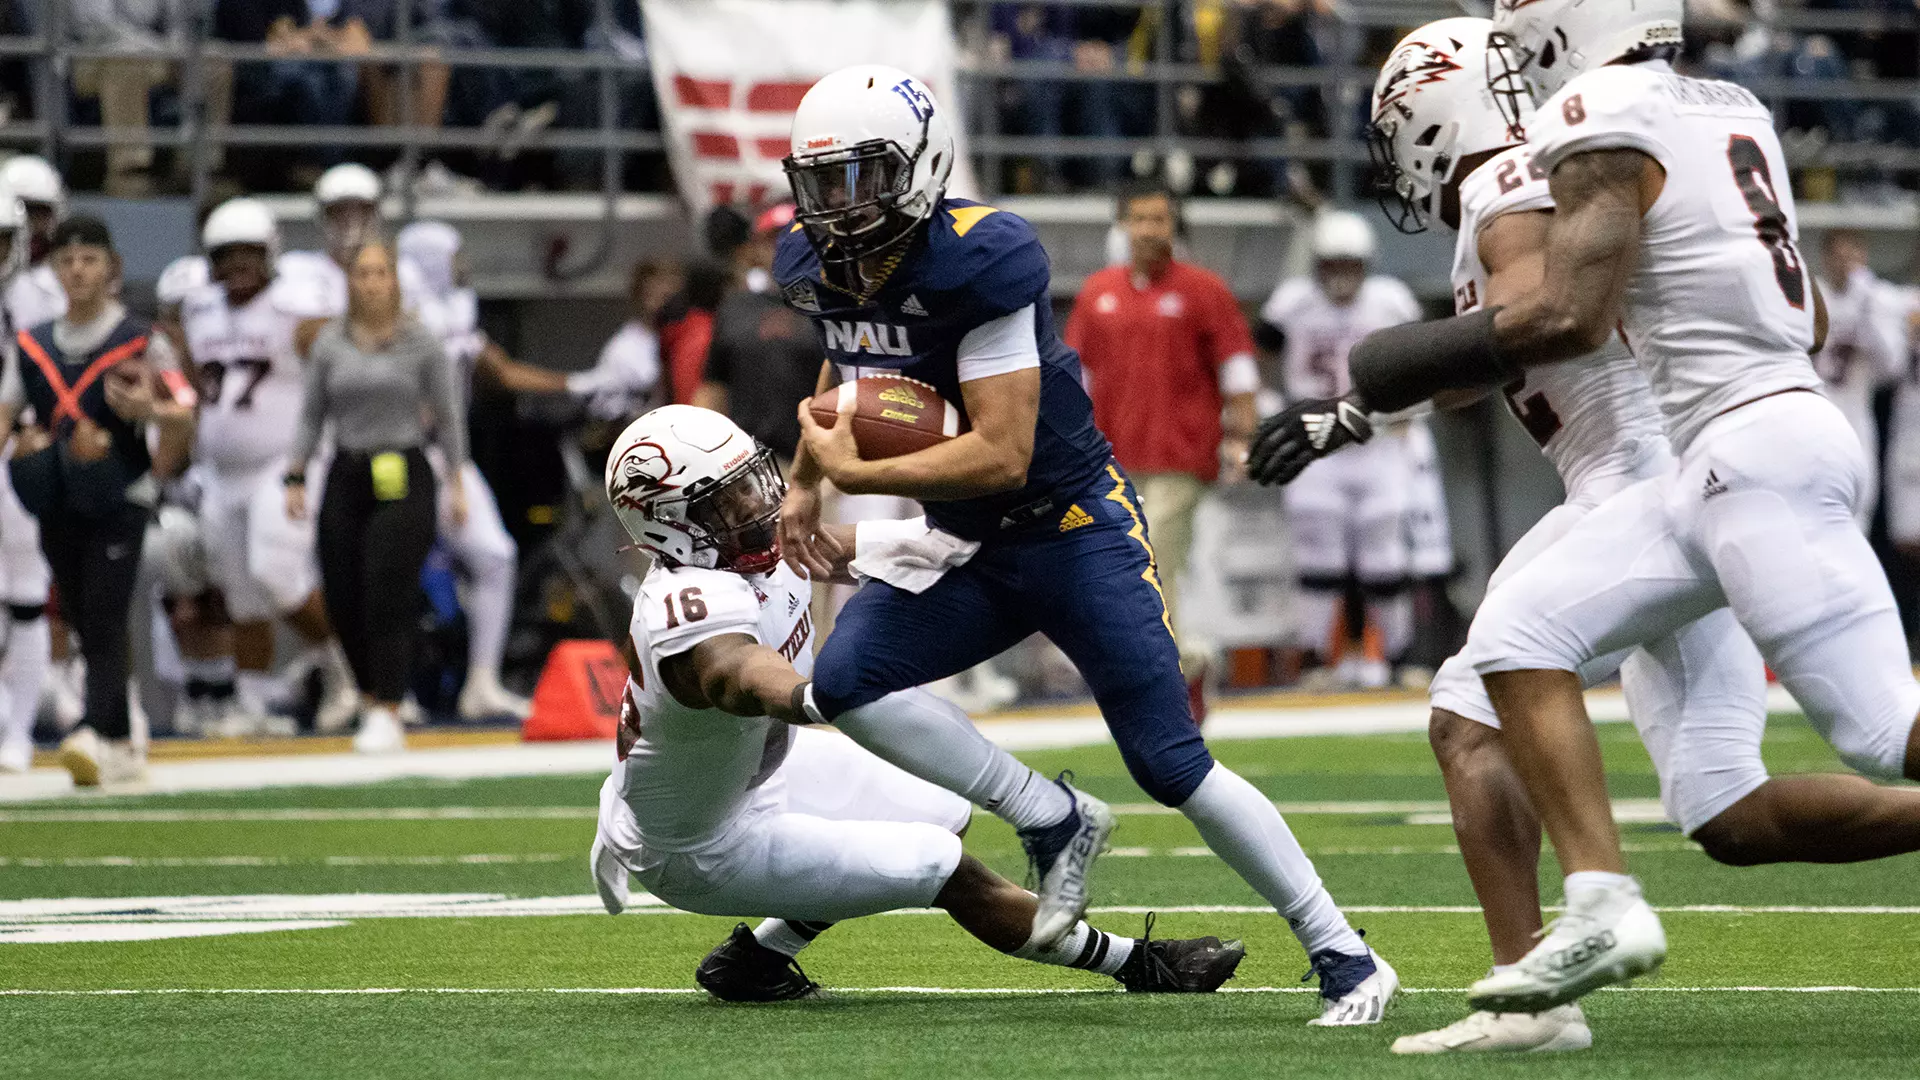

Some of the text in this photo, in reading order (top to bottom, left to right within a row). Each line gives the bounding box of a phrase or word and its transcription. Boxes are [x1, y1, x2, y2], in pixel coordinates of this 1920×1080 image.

[891, 79, 935, 123] 15
[1562, 93, 1587, 127] 8
[1726, 132, 1805, 312] 8
[821, 318, 914, 357] NAU
[722, 448, 751, 472] Riddell
[1058, 514, 1095, 533] adidas
[663, 585, 709, 630] 16
